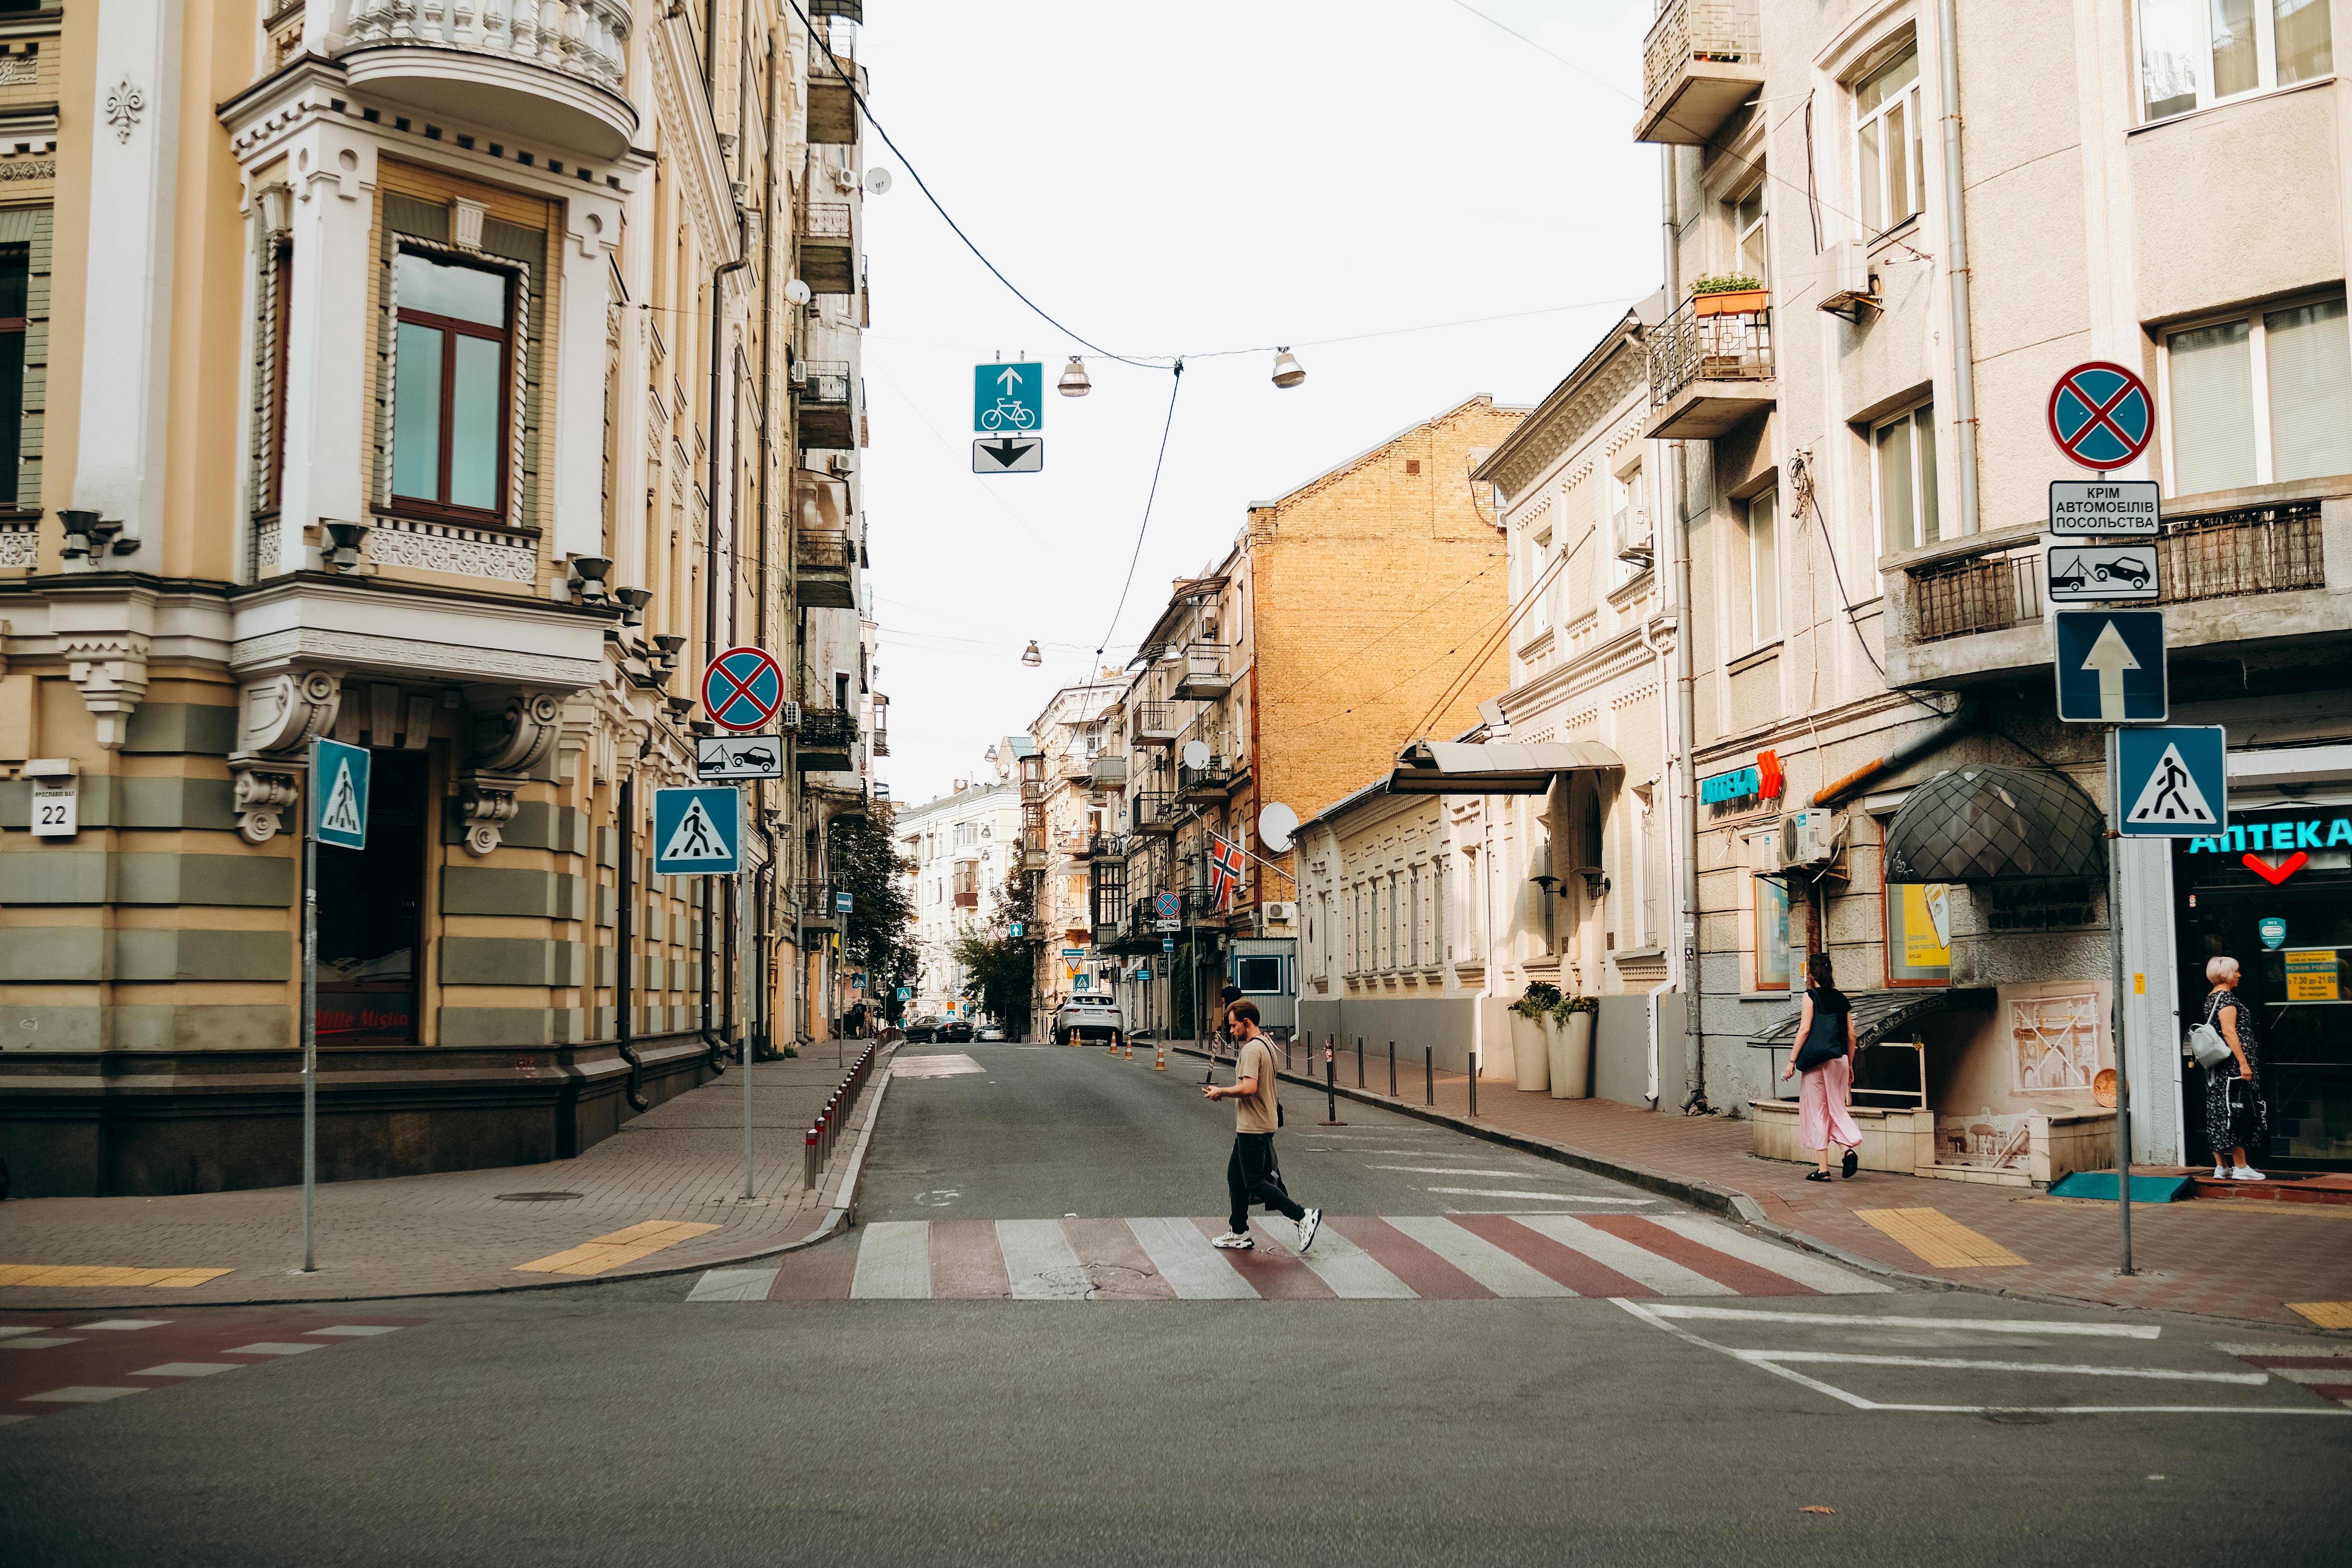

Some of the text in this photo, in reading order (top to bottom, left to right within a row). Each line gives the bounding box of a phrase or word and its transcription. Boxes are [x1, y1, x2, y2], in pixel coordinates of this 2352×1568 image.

[2087, 488, 2119, 498] КРІМ
[2055, 502, 2154, 513] АВТОМОБІЛІВ
[2056, 517, 2154, 528] ПОСОЛЬСТВА
[42, 805, 67, 825] 22
[316, 1008, 409, 1030] Mille Miglia
